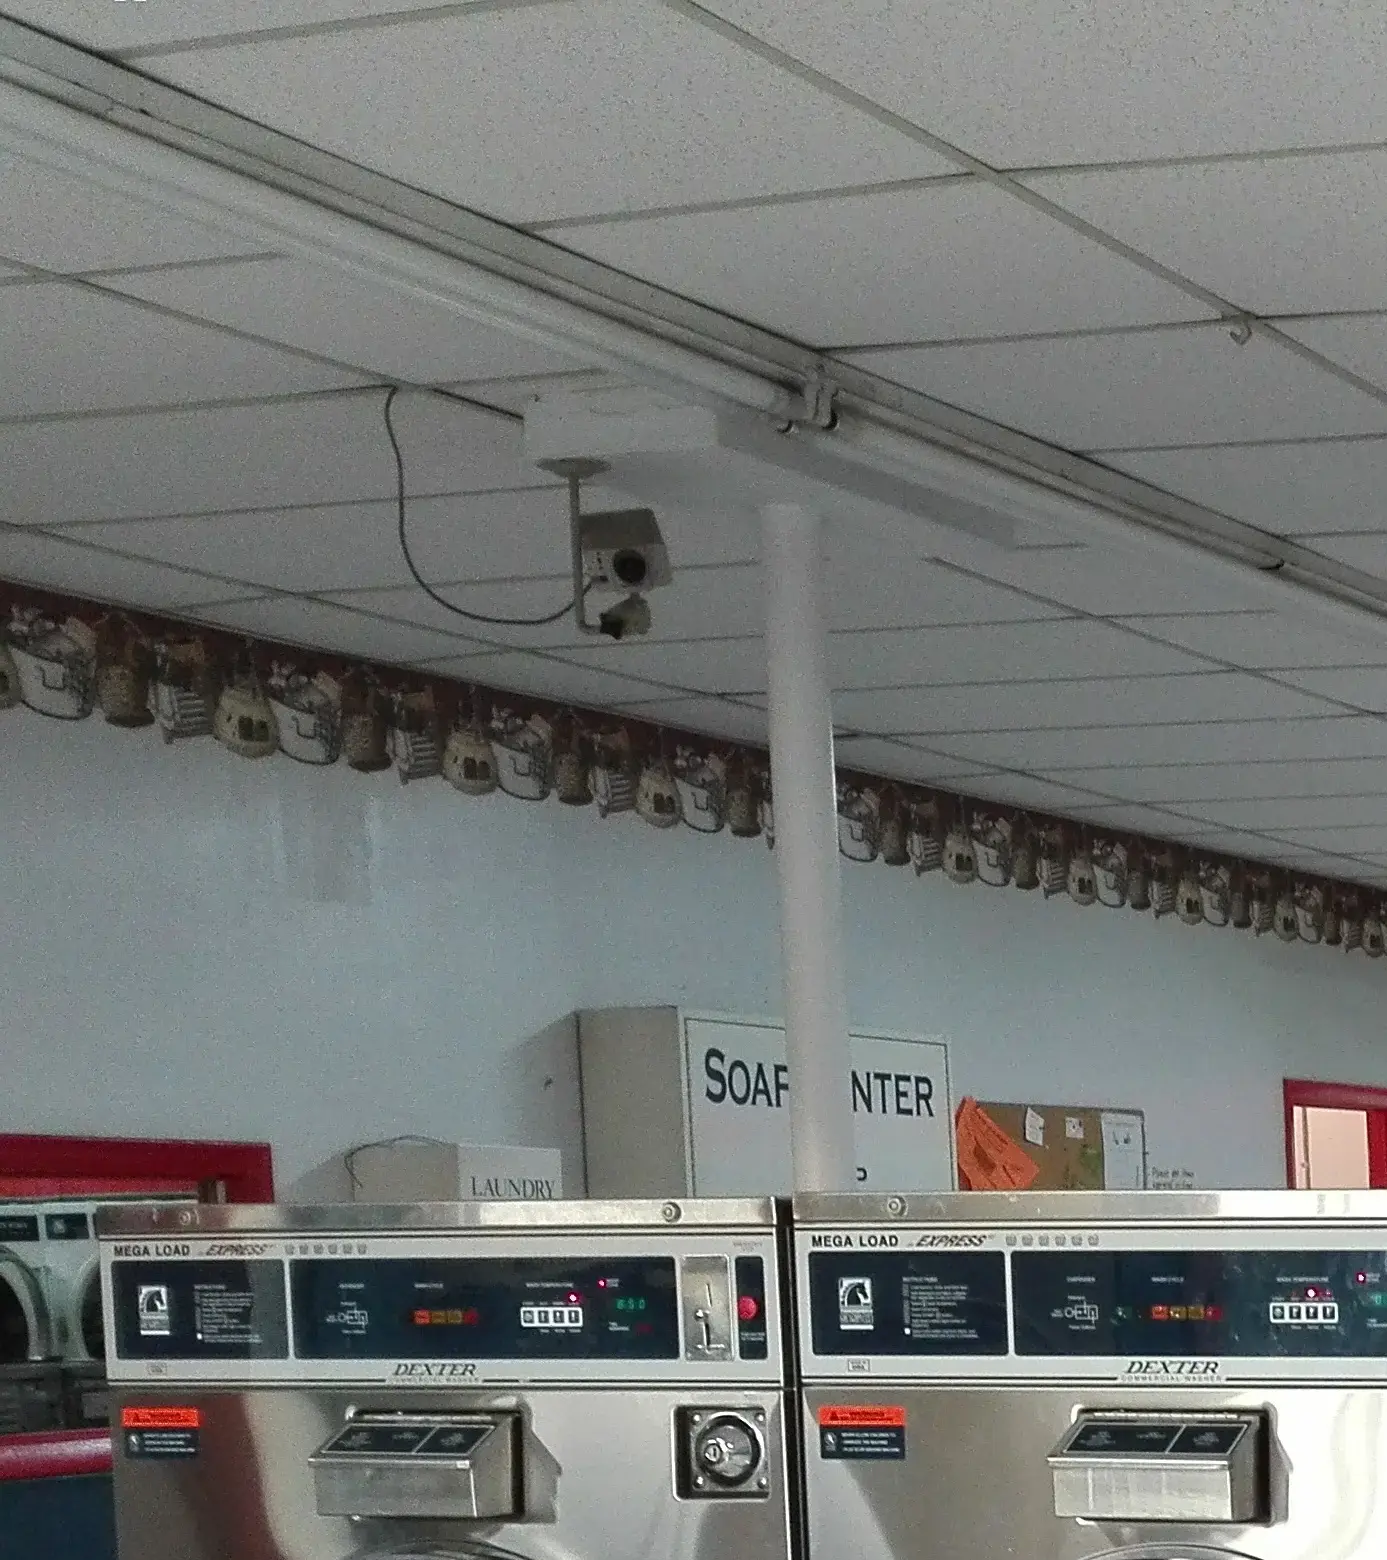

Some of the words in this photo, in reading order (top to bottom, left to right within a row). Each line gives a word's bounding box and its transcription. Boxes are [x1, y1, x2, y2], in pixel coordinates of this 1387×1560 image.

[471, 1175, 556, 1199] LAUNDRY
[811, 1235, 854, 1247] MEGA
[859, 1235, 899, 1247] LOAD
[914, 1235, 988, 1247] EXPRESS
[114, 1245, 150, 1257] MEGA
[155, 1245, 190, 1257] LOAD
[393, 1363, 477, 1376] DEXTER
[1124, 1361, 1220, 1375] DEXTER
